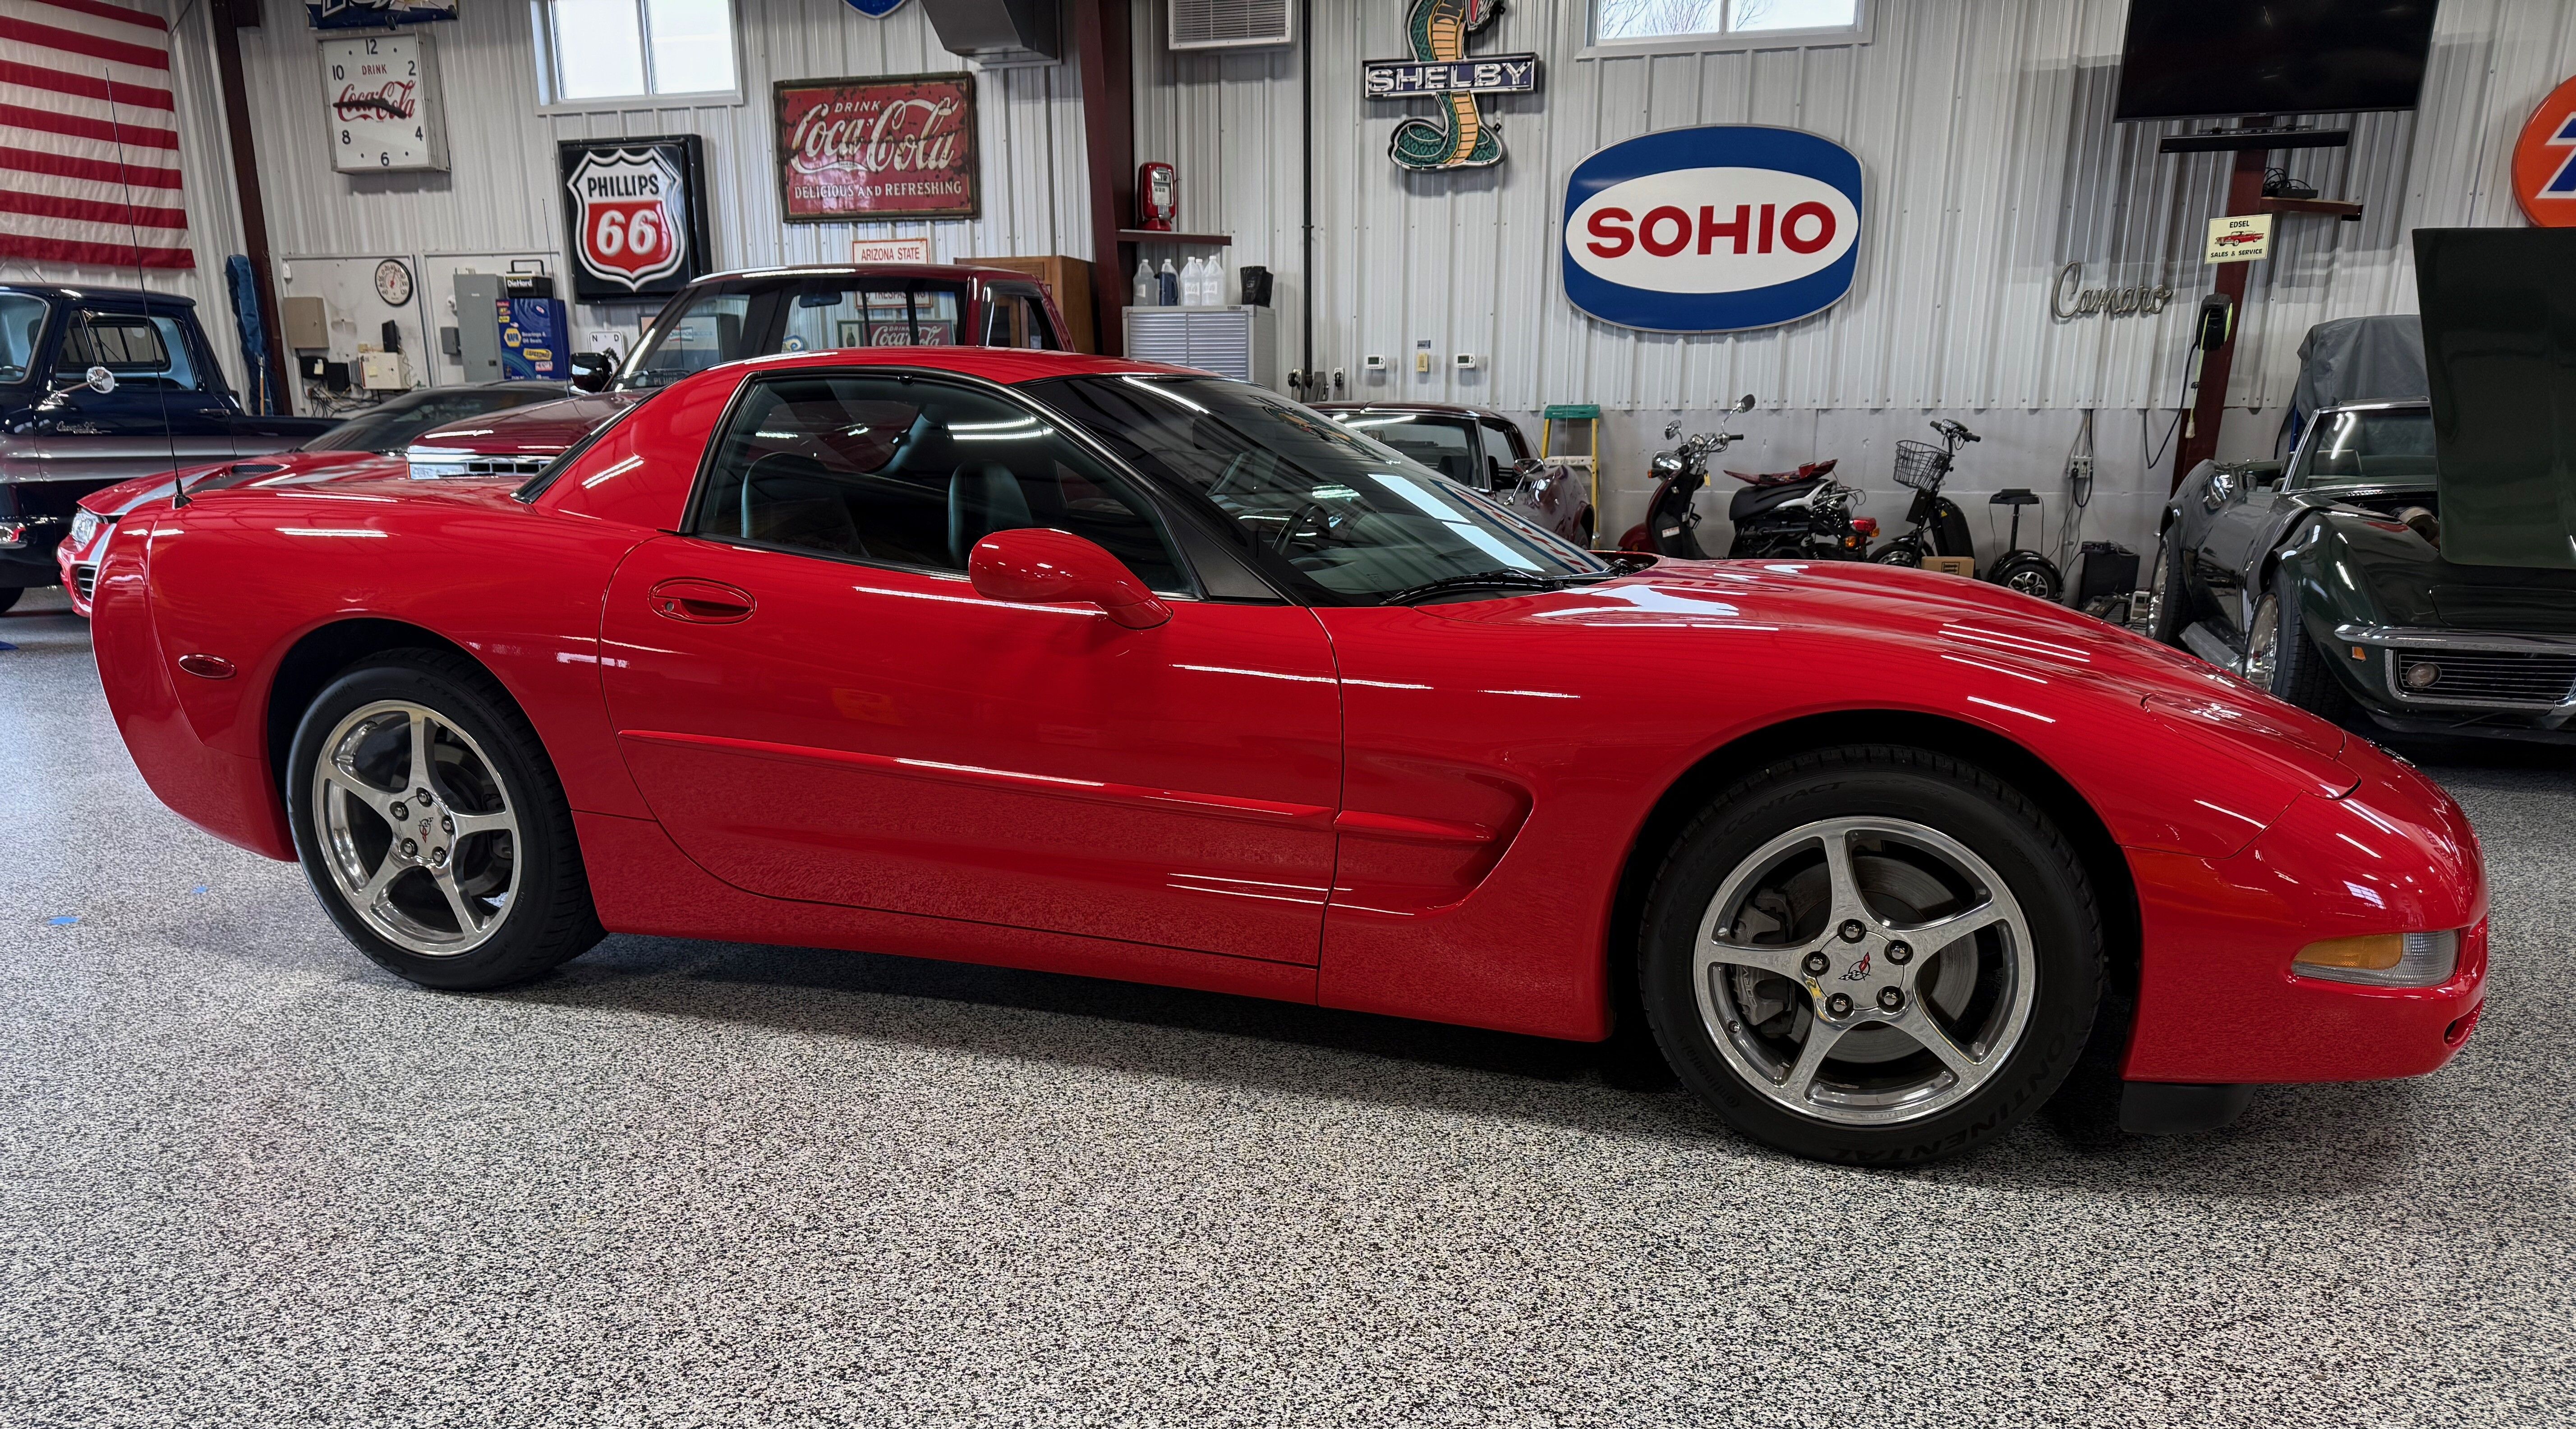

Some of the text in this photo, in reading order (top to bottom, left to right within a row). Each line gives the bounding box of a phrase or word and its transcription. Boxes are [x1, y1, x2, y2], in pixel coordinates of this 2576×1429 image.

[365, 39, 378, 55] 12
[332, 65, 344, 80] 10
[362, 64, 387, 75] DRINK
[408, 60, 416, 76] 2
[1368, 61, 1532, 92] SHELBY
[834, 100, 883, 114] DRINK
[342, 130, 351, 144] 8
[415, 126, 423, 141] 4
[790, 97, 959, 174] Coca-Cola
[381, 152, 390, 166] 6
[588, 173, 659, 198] PHILLIPS
[794, 181, 962, 199] DELICIOUS AND REFRESHING
[1586, 201, 1837, 258] SOHIO
[2229, 220, 2250, 229] EDSEL
[596, 209, 659, 258] 66
[861, 247, 920, 261] ARIZONA STATE
[2052, 260, 2173, 318] Camaro
